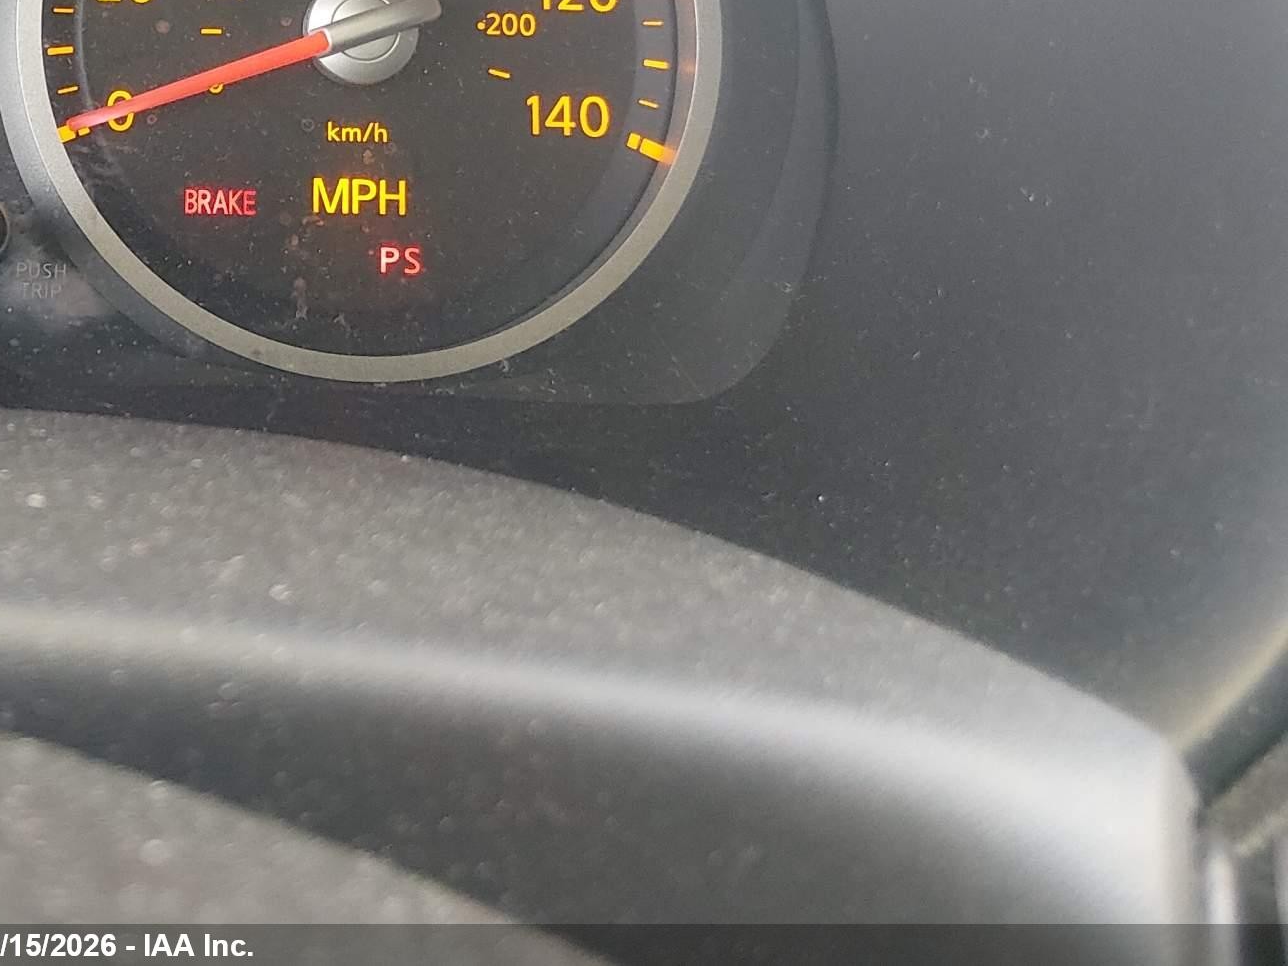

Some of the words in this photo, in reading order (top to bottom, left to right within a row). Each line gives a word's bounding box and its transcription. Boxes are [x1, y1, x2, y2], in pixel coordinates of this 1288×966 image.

[485, 13, 537, 37] 200
[106, 90, 135, 132] 0
[526, 95, 610, 139] 140
[326, 120, 389, 144] km/h
[184, 189, 257, 216] BRAKE
[312, 178, 408, 216] MPH
[16, 263, 67, 281] PUSH
[380, 247, 422, 275] PS
[19, 281, 63, 299] TRIP
